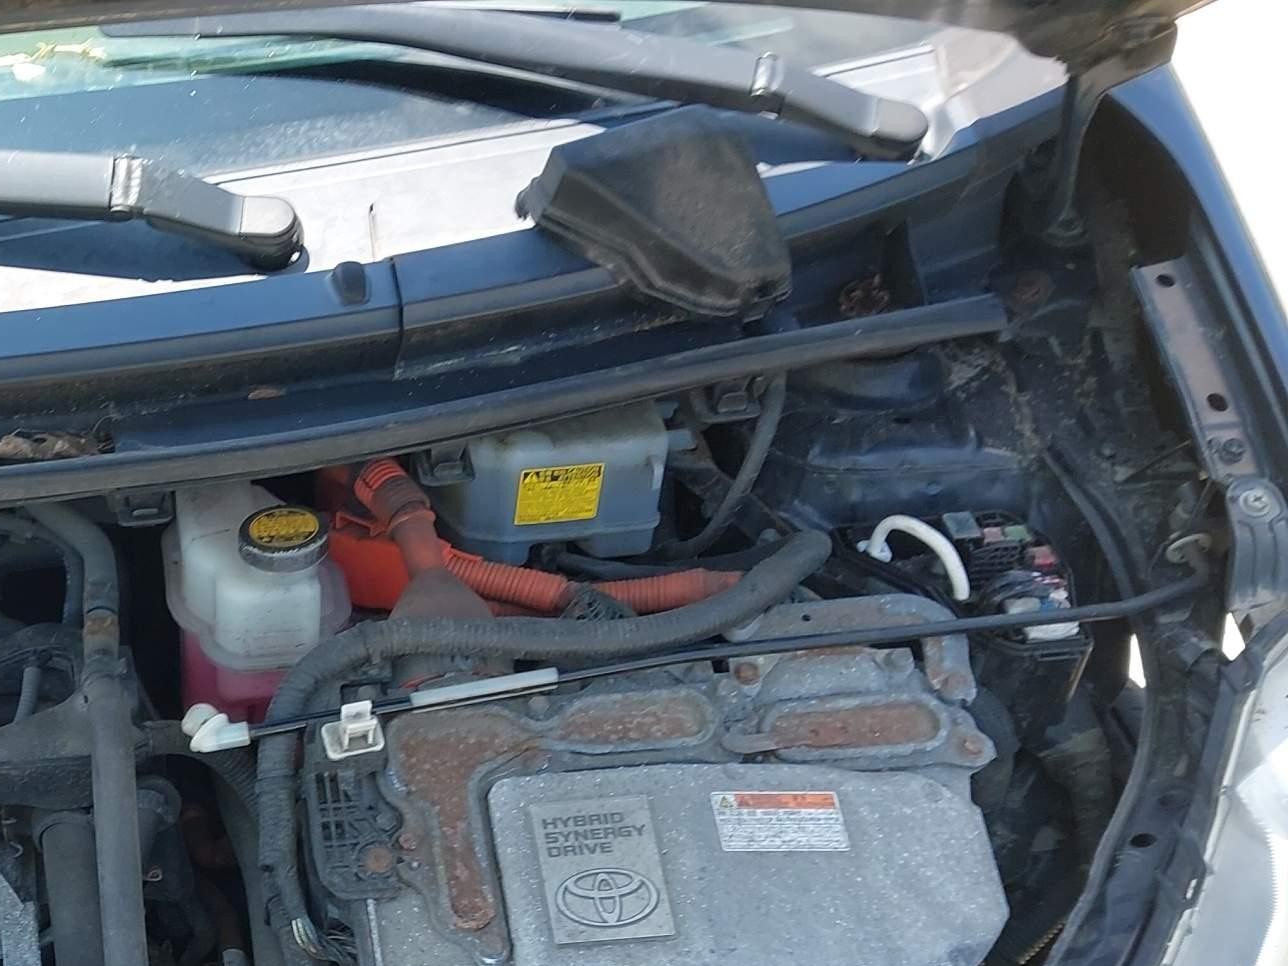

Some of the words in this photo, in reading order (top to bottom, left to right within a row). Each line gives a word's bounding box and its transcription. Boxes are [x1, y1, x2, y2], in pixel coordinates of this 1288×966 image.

[542, 812, 624, 830] HYBRID
[544, 824, 646, 844] SYNERGY
[547, 842, 614, 858] DRIVE
